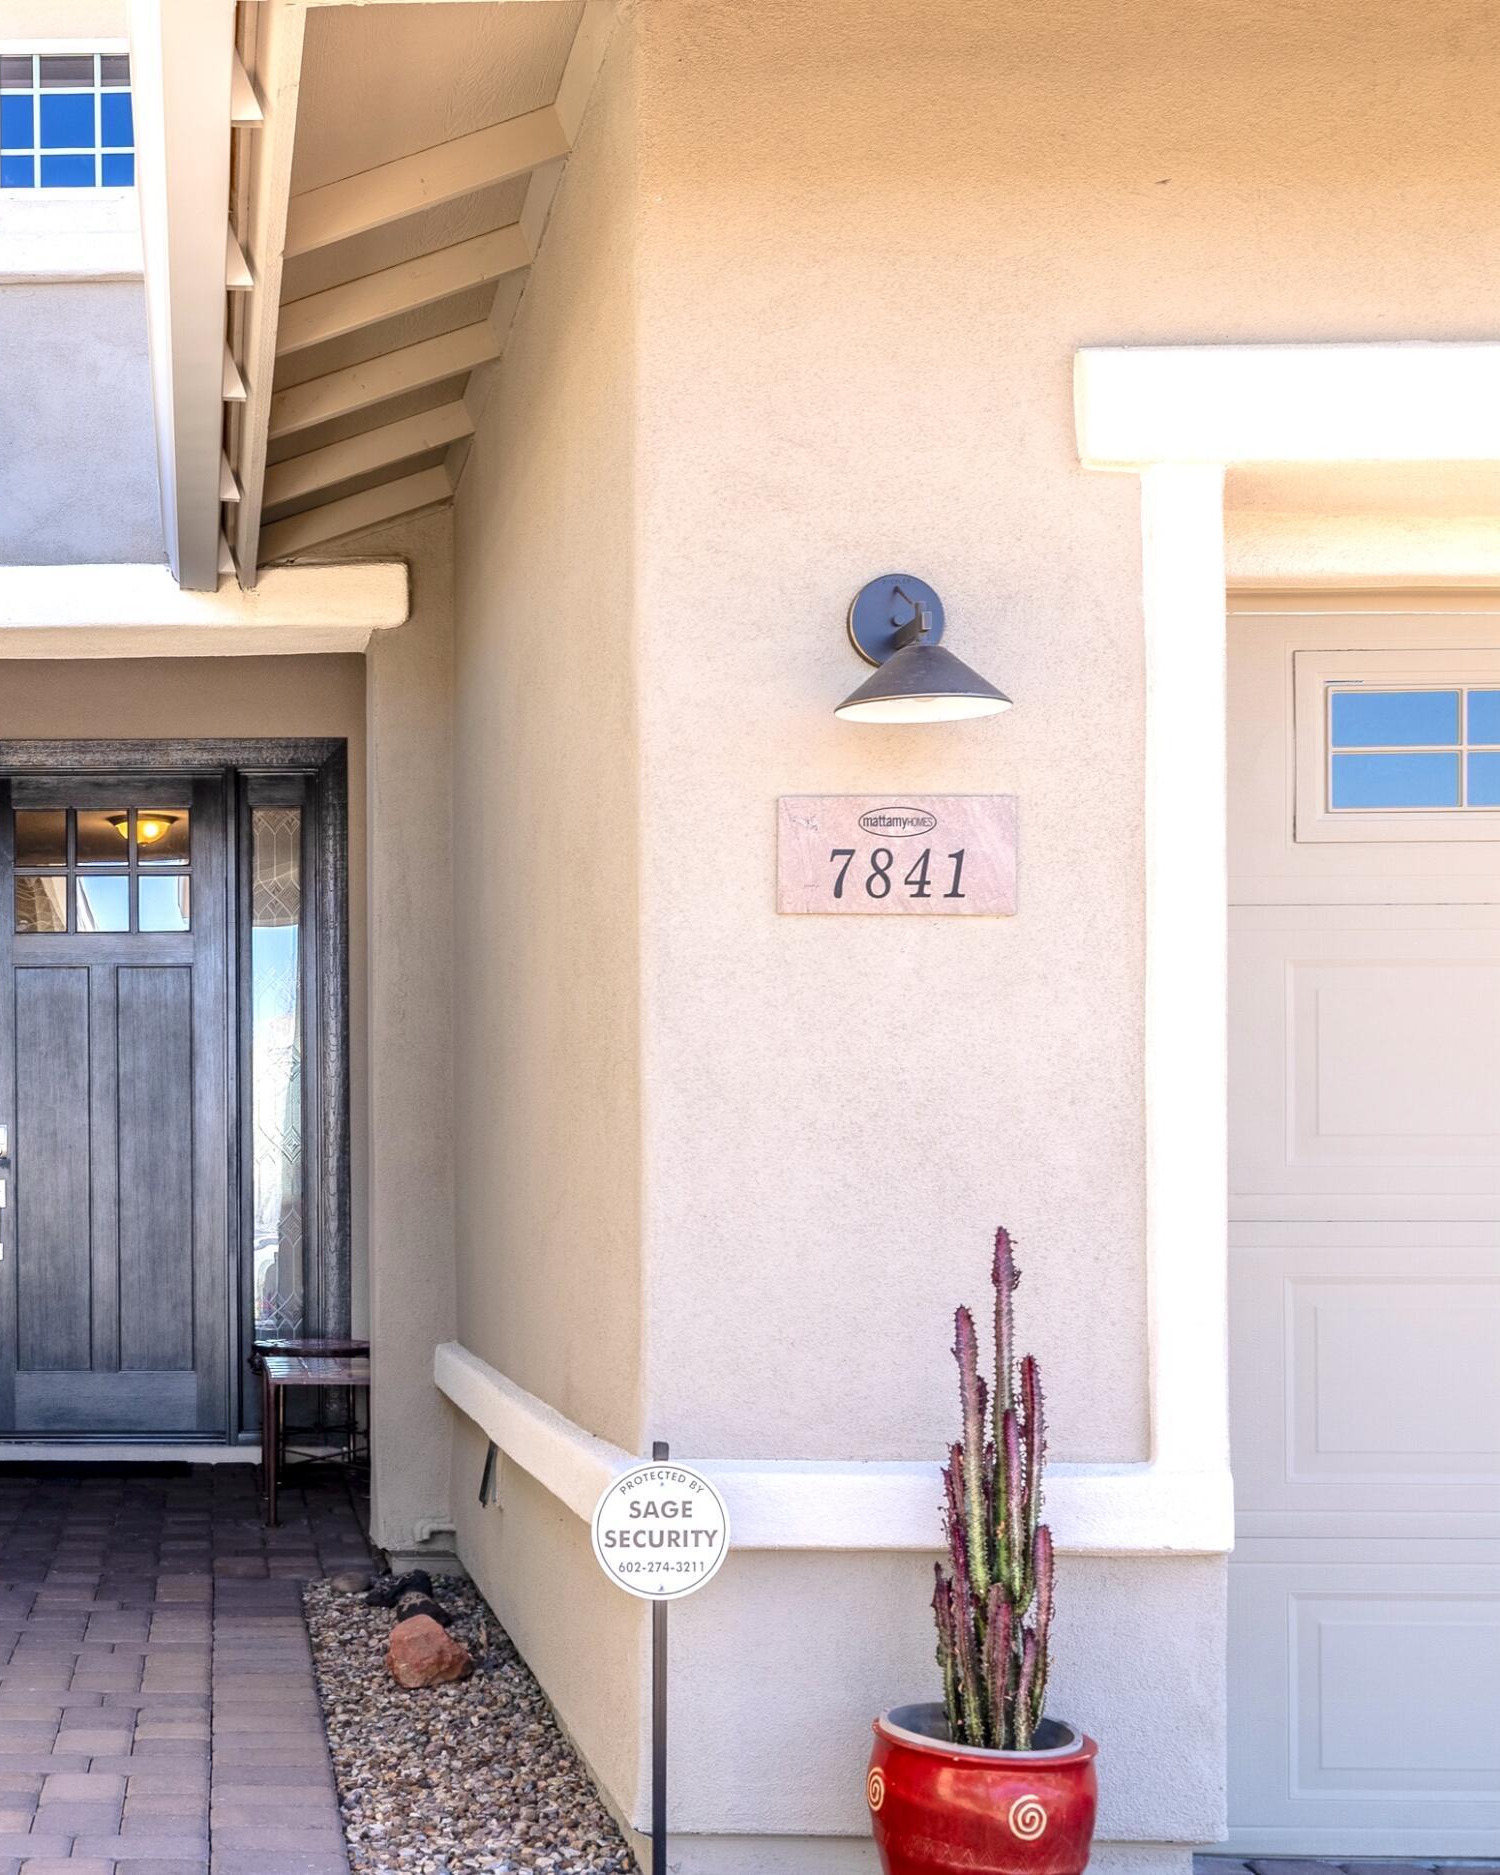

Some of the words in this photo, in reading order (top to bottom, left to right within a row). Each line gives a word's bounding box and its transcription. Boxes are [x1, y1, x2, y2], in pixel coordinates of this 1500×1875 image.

[829, 848, 966, 899] 7841
[619, 1471, 686, 1495] PROTECTED
[688, 1480, 705, 1494] BY
[628, 1500, 693, 1519] SAGE
[604, 1529, 718, 1548] SECURITY
[618, 1561, 705, 1573] 602-274-3211
